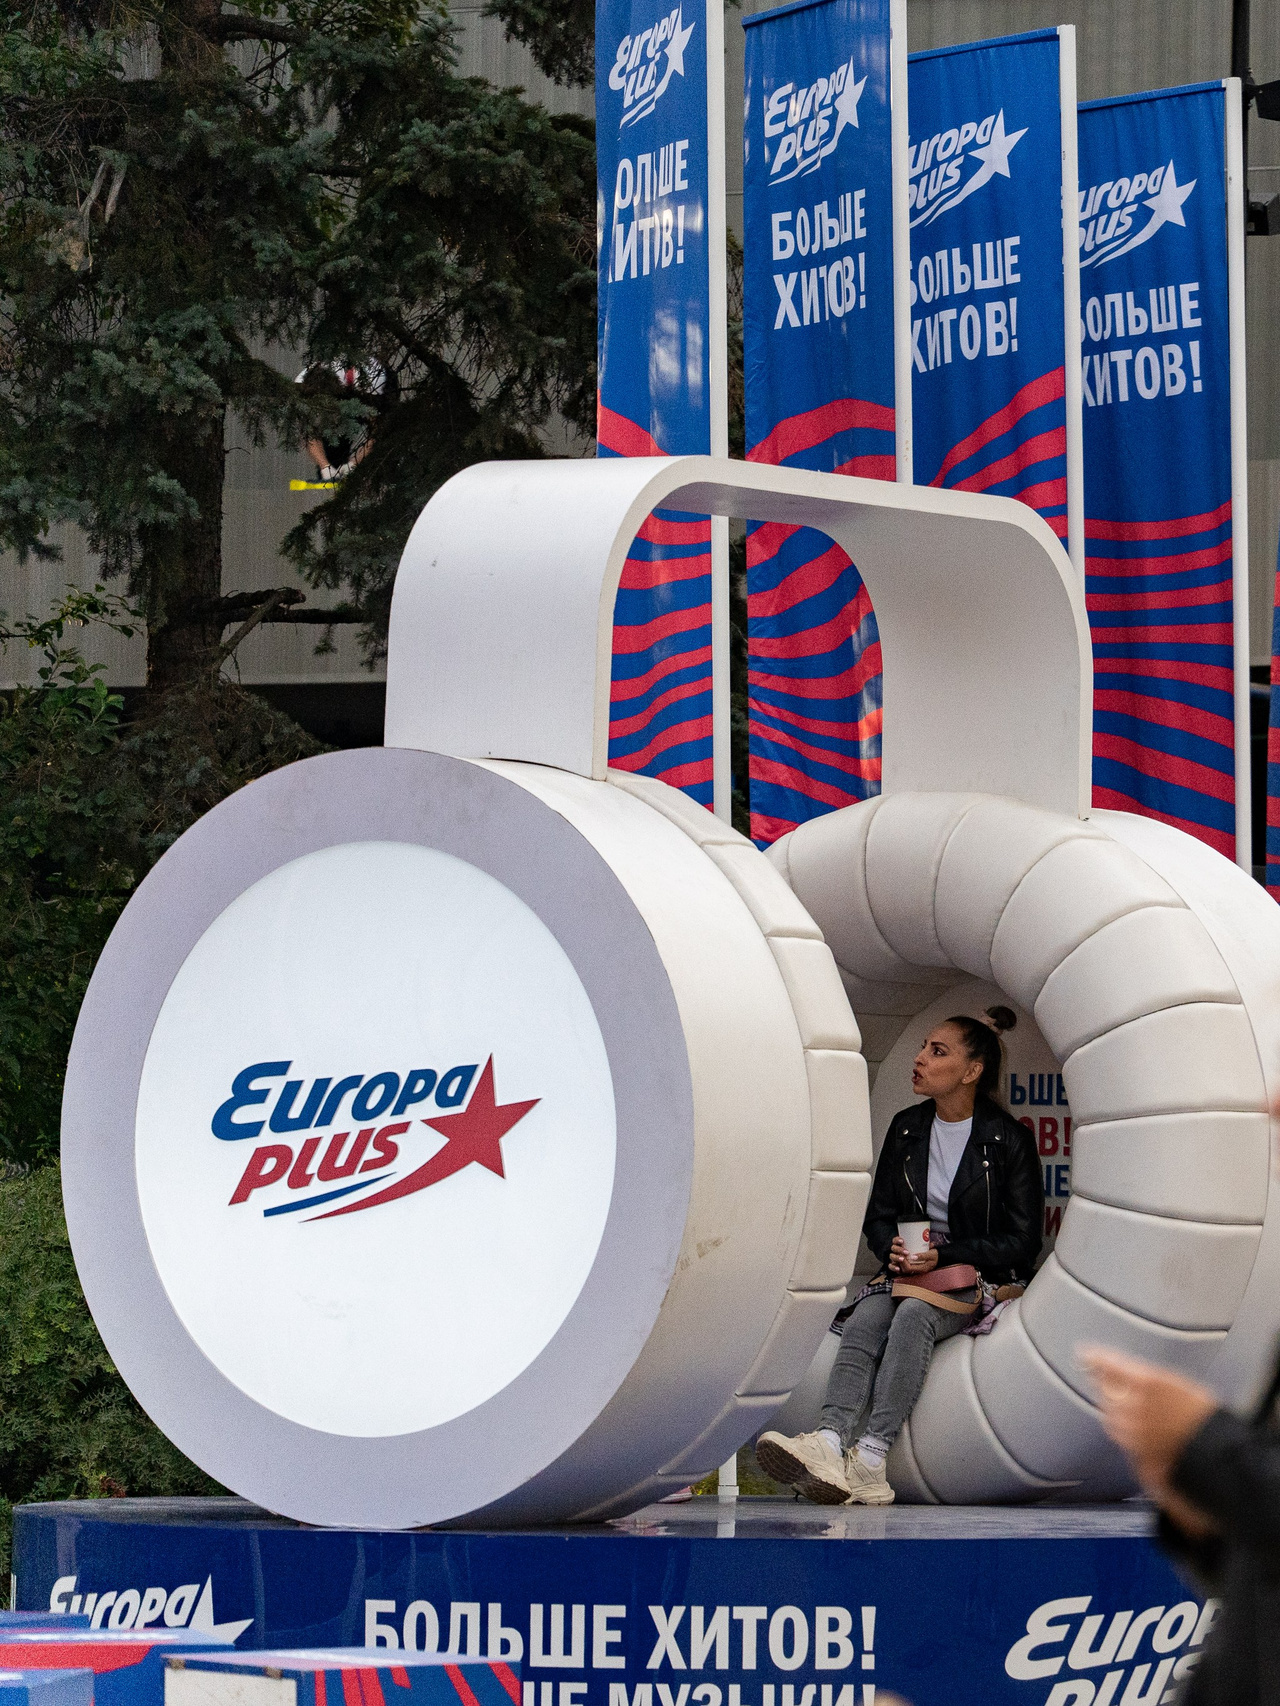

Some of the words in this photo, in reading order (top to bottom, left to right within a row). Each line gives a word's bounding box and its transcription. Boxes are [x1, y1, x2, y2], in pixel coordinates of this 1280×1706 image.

[908, 114, 996, 180] uropa
[771, 188, 867, 261] БОЛЬШЕ
[1077, 165, 1165, 222] uropa
[772, 252, 866, 330] ХИТОВ!
[211, 1060, 479, 1141] Europa
[364, 1599, 627, 1669] БОЛЬШЕ
[646, 1605, 877, 1671] ХИТОВ!
[1004, 1595, 1222, 1681] Europ
